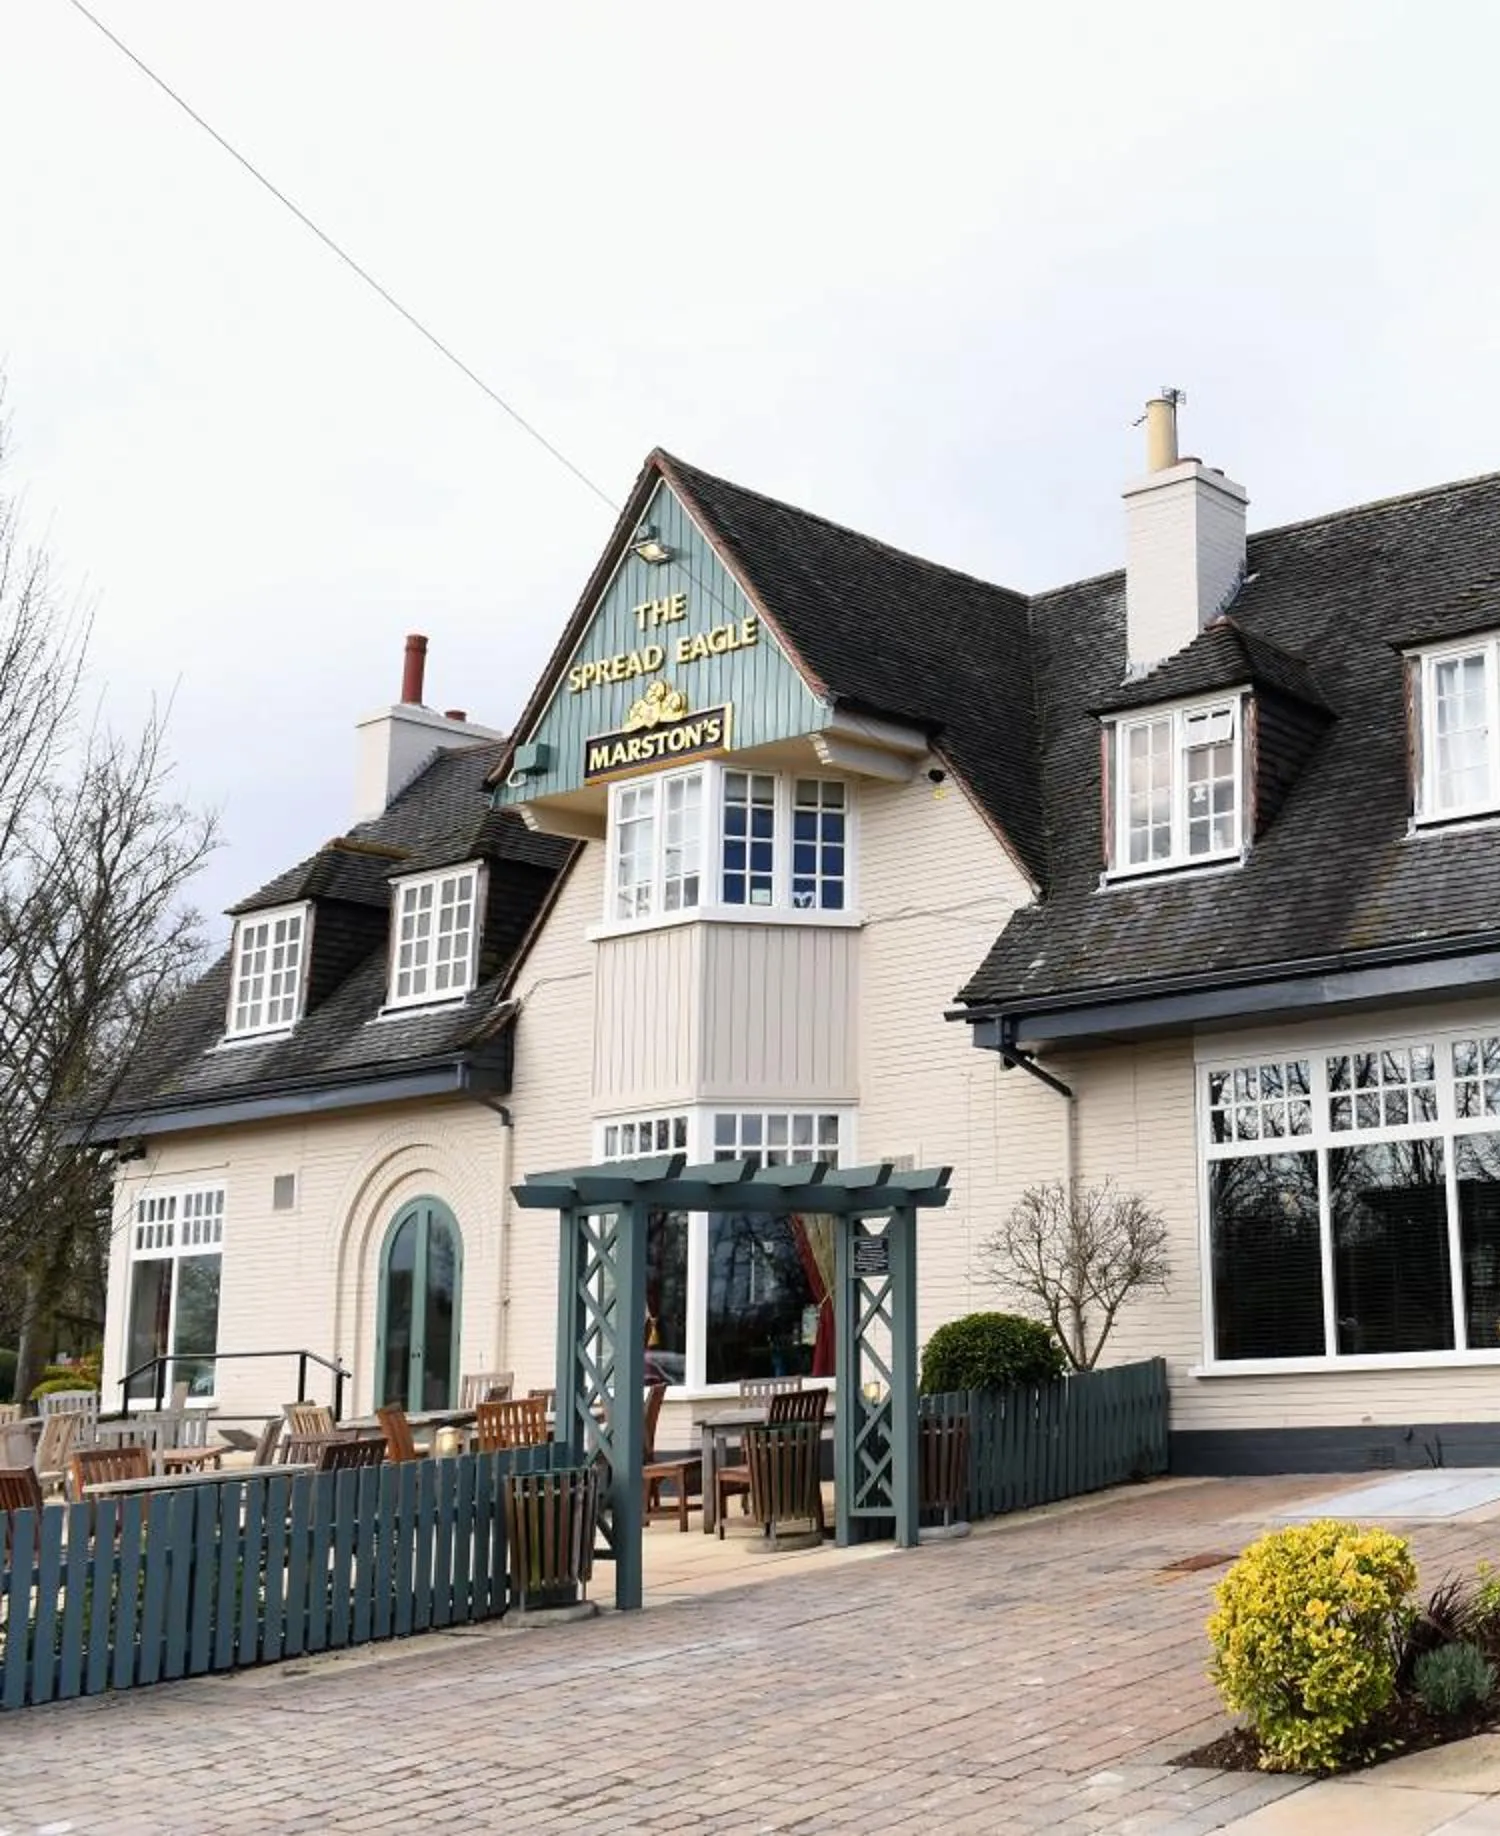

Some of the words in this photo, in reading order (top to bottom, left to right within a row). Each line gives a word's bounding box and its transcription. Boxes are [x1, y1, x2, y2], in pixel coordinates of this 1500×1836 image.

[633, 592, 688, 631] THE
[568, 645, 664, 694] SPREAD
[676, 616, 759, 664] EAGLE
[588, 717, 722, 772] MARSTON'S
